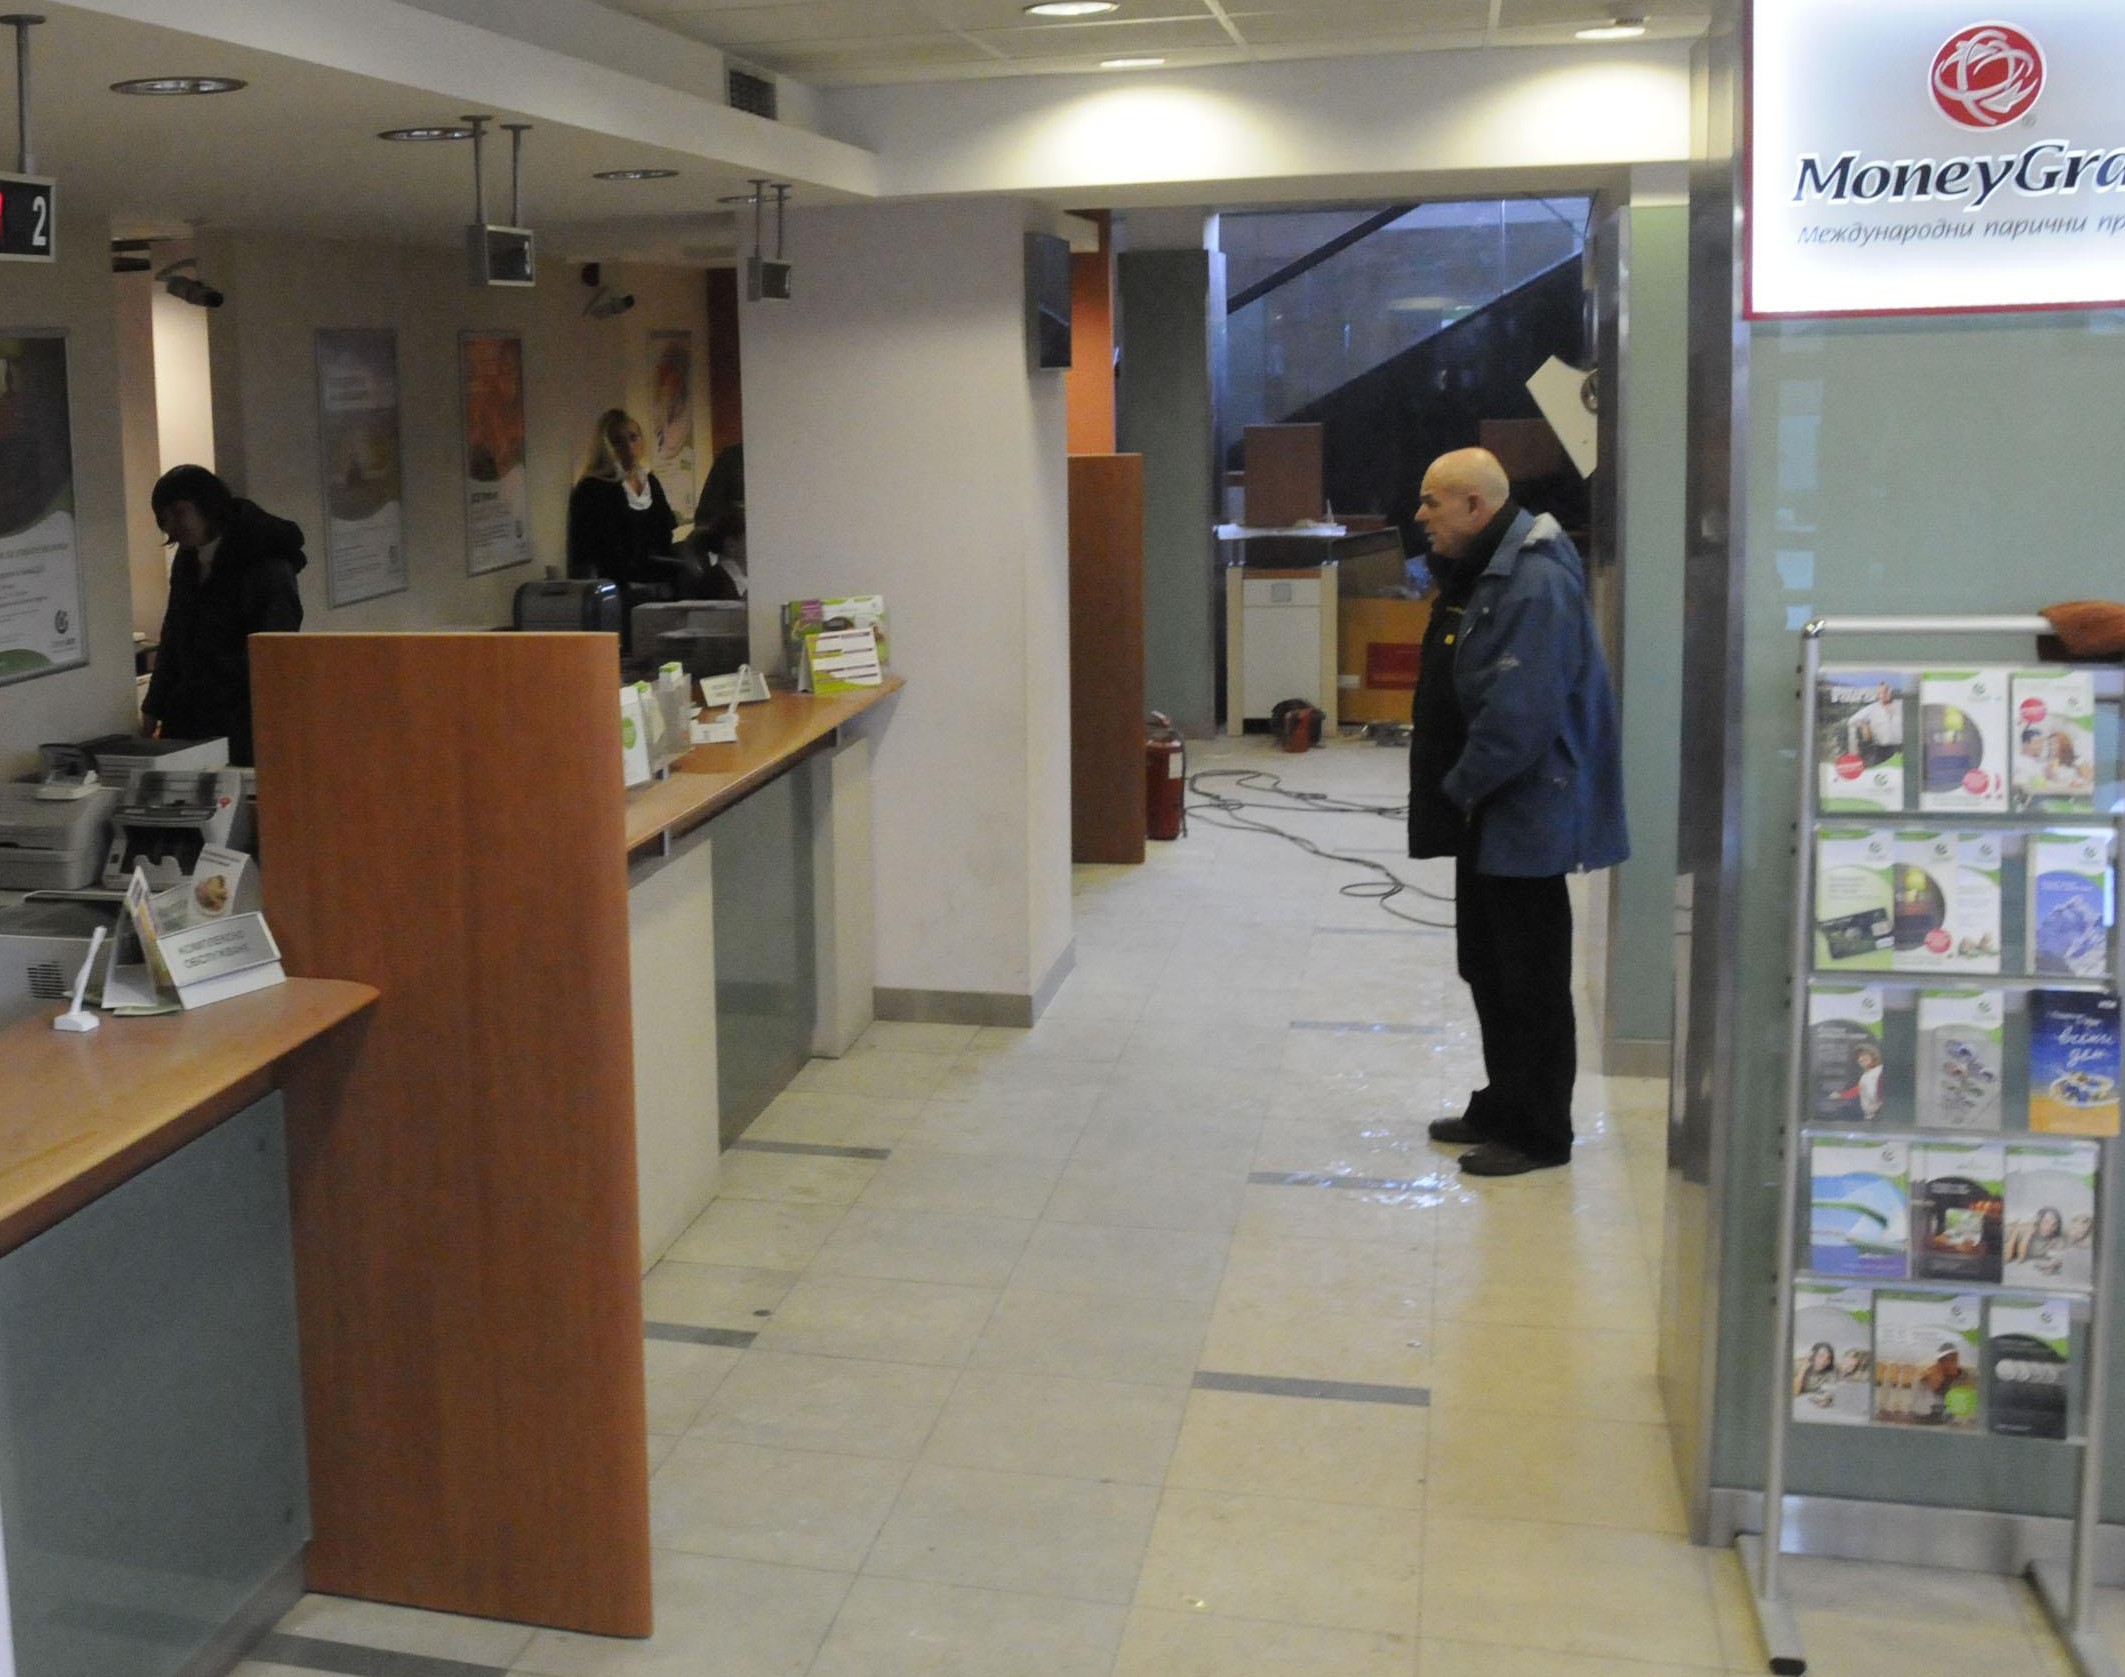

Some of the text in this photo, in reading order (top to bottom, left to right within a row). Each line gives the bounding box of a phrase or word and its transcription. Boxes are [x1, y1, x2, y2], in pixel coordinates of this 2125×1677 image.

[1791, 142, 2125, 208] MoneyGra
[32, 195, 47, 246] 2
[1797, 217, 1976, 248] Международни
[1983, 215, 2088, 242] парични
